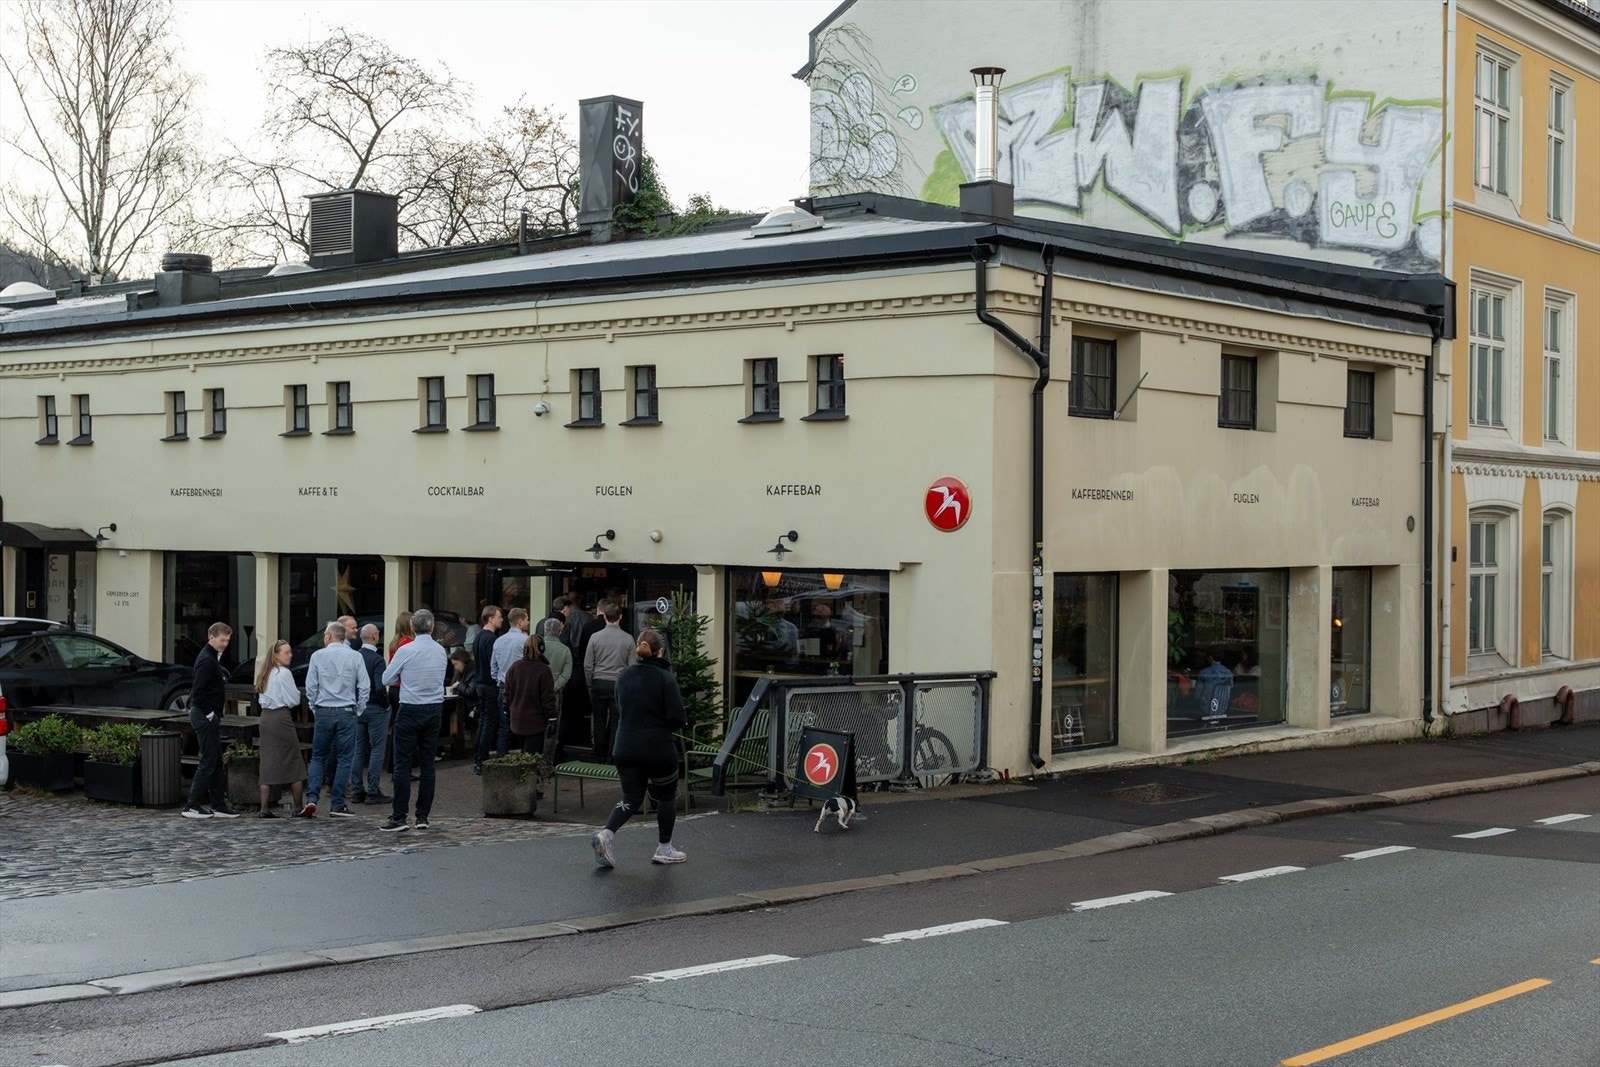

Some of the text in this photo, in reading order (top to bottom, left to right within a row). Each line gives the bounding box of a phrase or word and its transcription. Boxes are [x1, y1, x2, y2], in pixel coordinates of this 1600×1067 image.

[1330, 201, 1398, 239] GAUPE
[170, 488, 223, 497] KAFFEBRENNERI
[298, 486, 338, 496] KAFFE & TE
[427, 486, 485, 496] COCKTAILBAR
[595, 485, 633, 496] FUGLEN
[766, 484, 822, 496] KAFFEBAR
[1071, 488, 1134, 501] KAFFEBRENNERI
[1233, 493, 1260, 504] FUGLEN
[1351, 497, 1380, 507] KAFFEBAR
